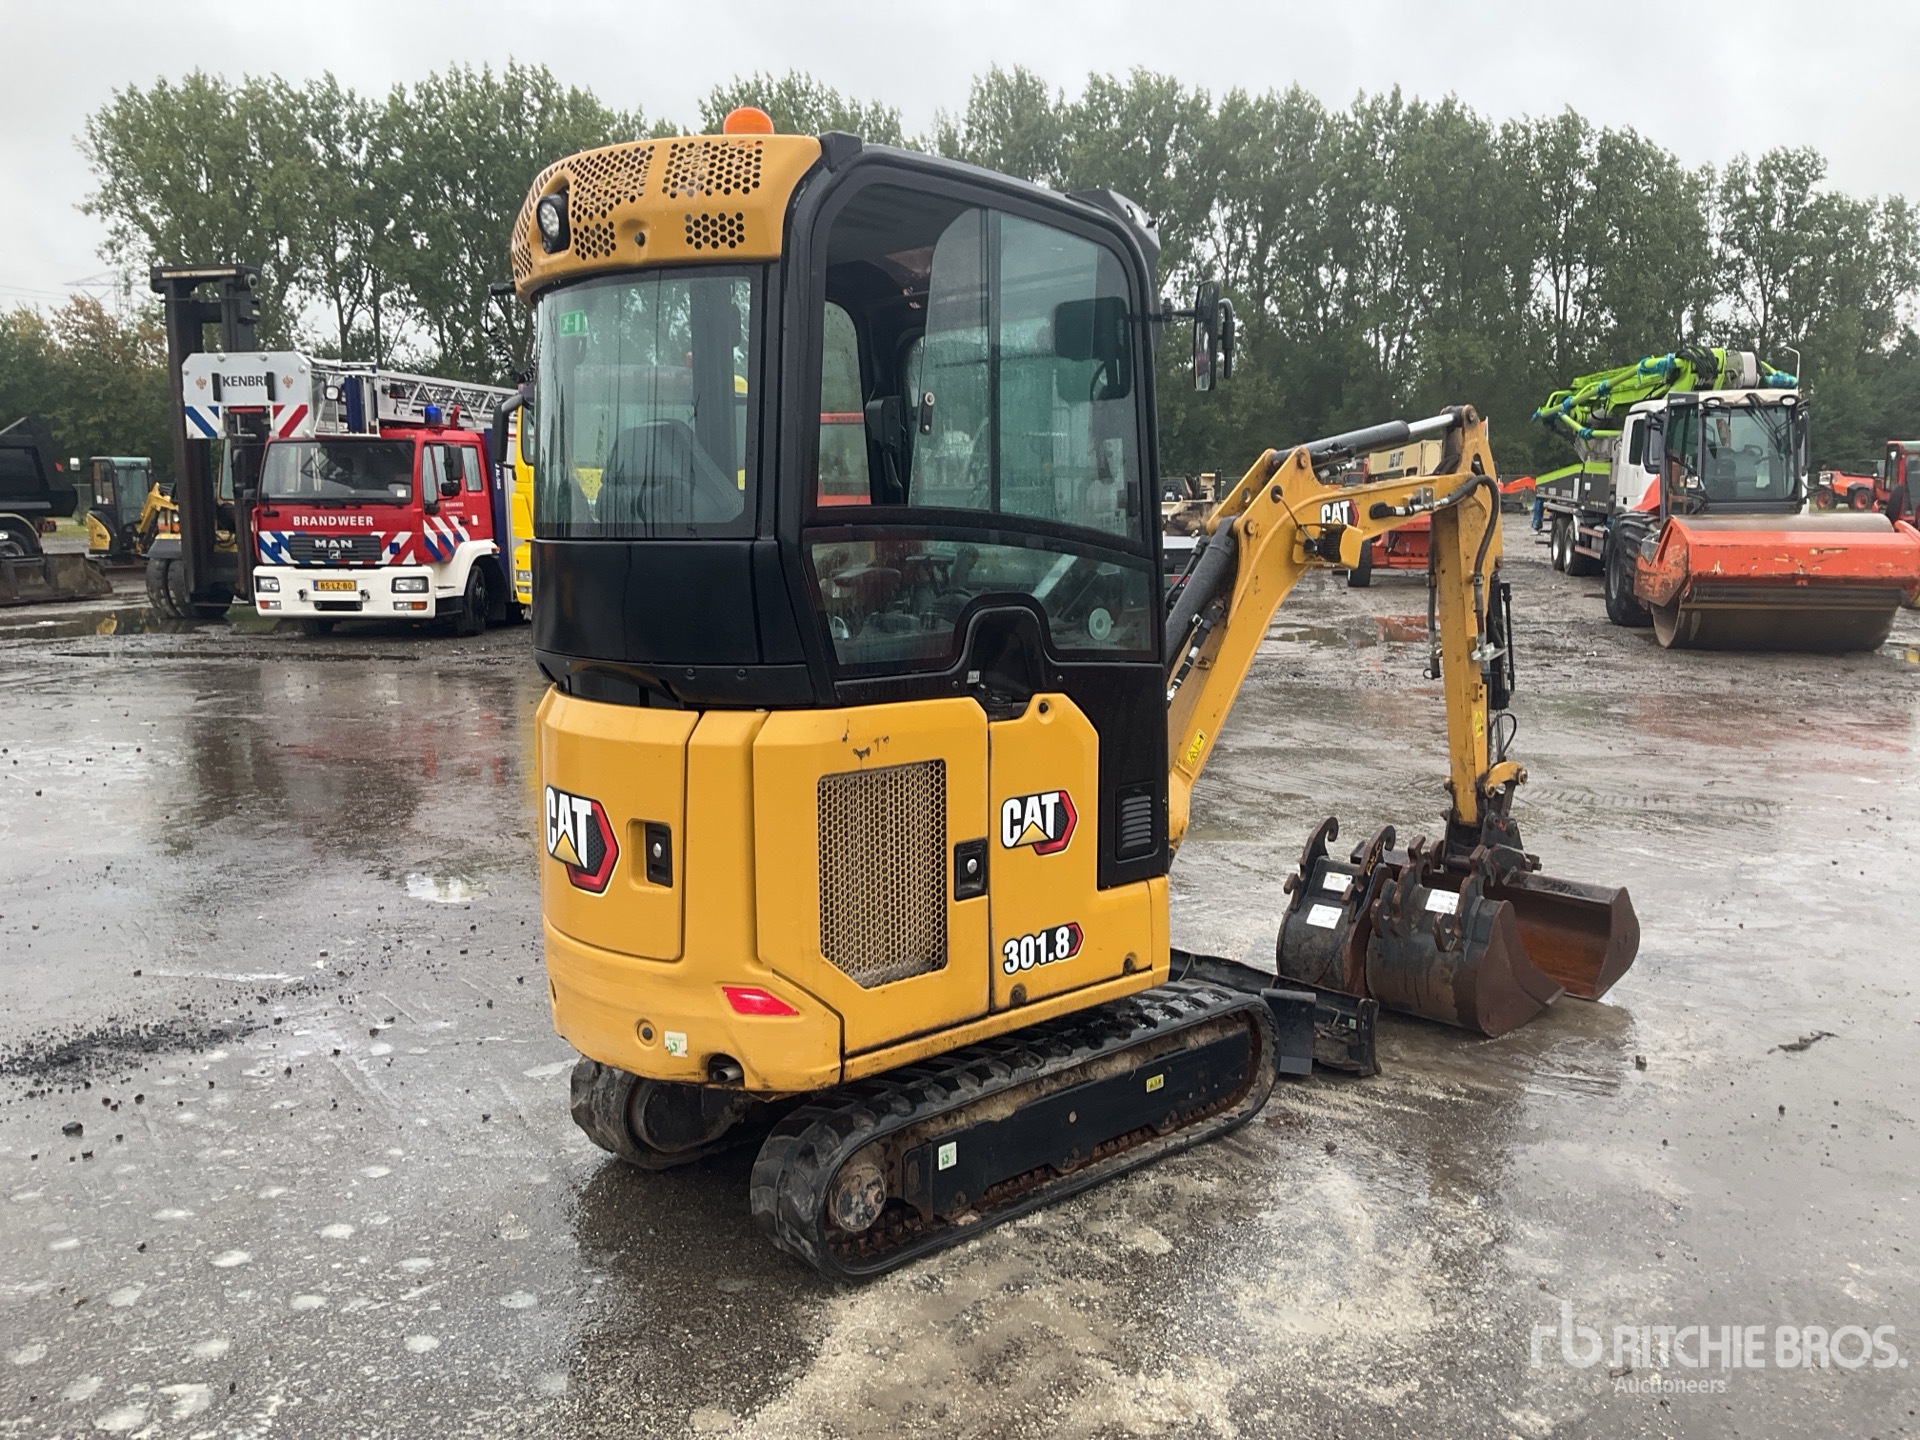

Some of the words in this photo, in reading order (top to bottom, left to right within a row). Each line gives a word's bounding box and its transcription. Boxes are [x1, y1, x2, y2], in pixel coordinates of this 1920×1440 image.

[293, 516, 374, 526] BRANDWEER
[1321, 500, 1350, 524] CAT
[314, 540, 353, 548] MAN
[546, 787, 592, 869] CAT
[1002, 792, 1060, 848] CAT
[1004, 926, 1070, 973] 301.8
